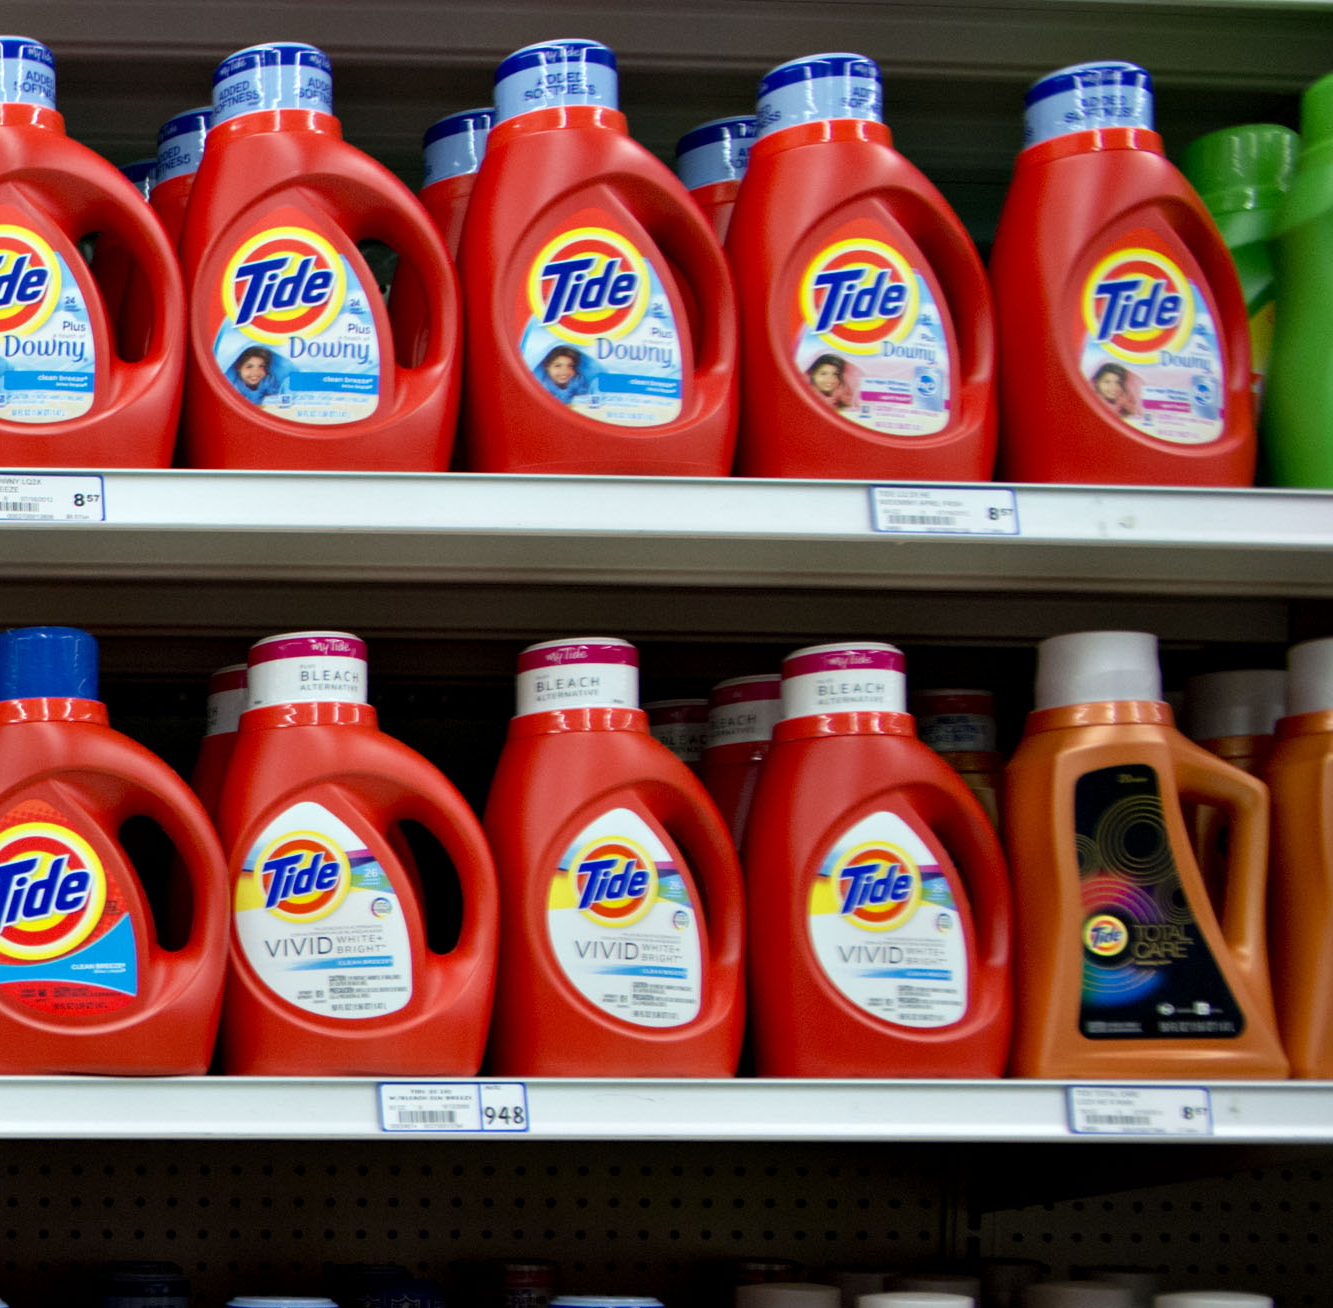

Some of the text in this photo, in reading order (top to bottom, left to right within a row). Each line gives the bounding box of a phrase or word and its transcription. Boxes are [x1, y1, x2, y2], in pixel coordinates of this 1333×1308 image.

[234, 255, 334, 328] Tide
[540, 257, 640, 327] Tide
[813, 268, 908, 335] Tide
[1094, 279, 1183, 343] Tide
[62, 321, 87, 332] Plus
[4, 335, 85, 363] Downy
[289, 338, 370, 365] Downy
[596, 338, 673, 367] Downy
[300, 669, 359, 683] BLEACH
[536, 676, 601, 692] BLEACH
[818, 681, 885, 696] BLEACH
[261, 853, 341, 909] Tide
[576, 859, 651, 910] Tide
[839, 864, 914, 915] Tide
[1090, 926, 1121, 947] Tide
[1134, 924, 1192, 943] TOTAL
[265, 937, 333, 959] VIVID
[575, 940, 638, 961] VIVID
[838, 945, 903, 964] VIVID
[1134, 941, 1188, 958] CARE
[483, 1106, 525, 1125] 948
